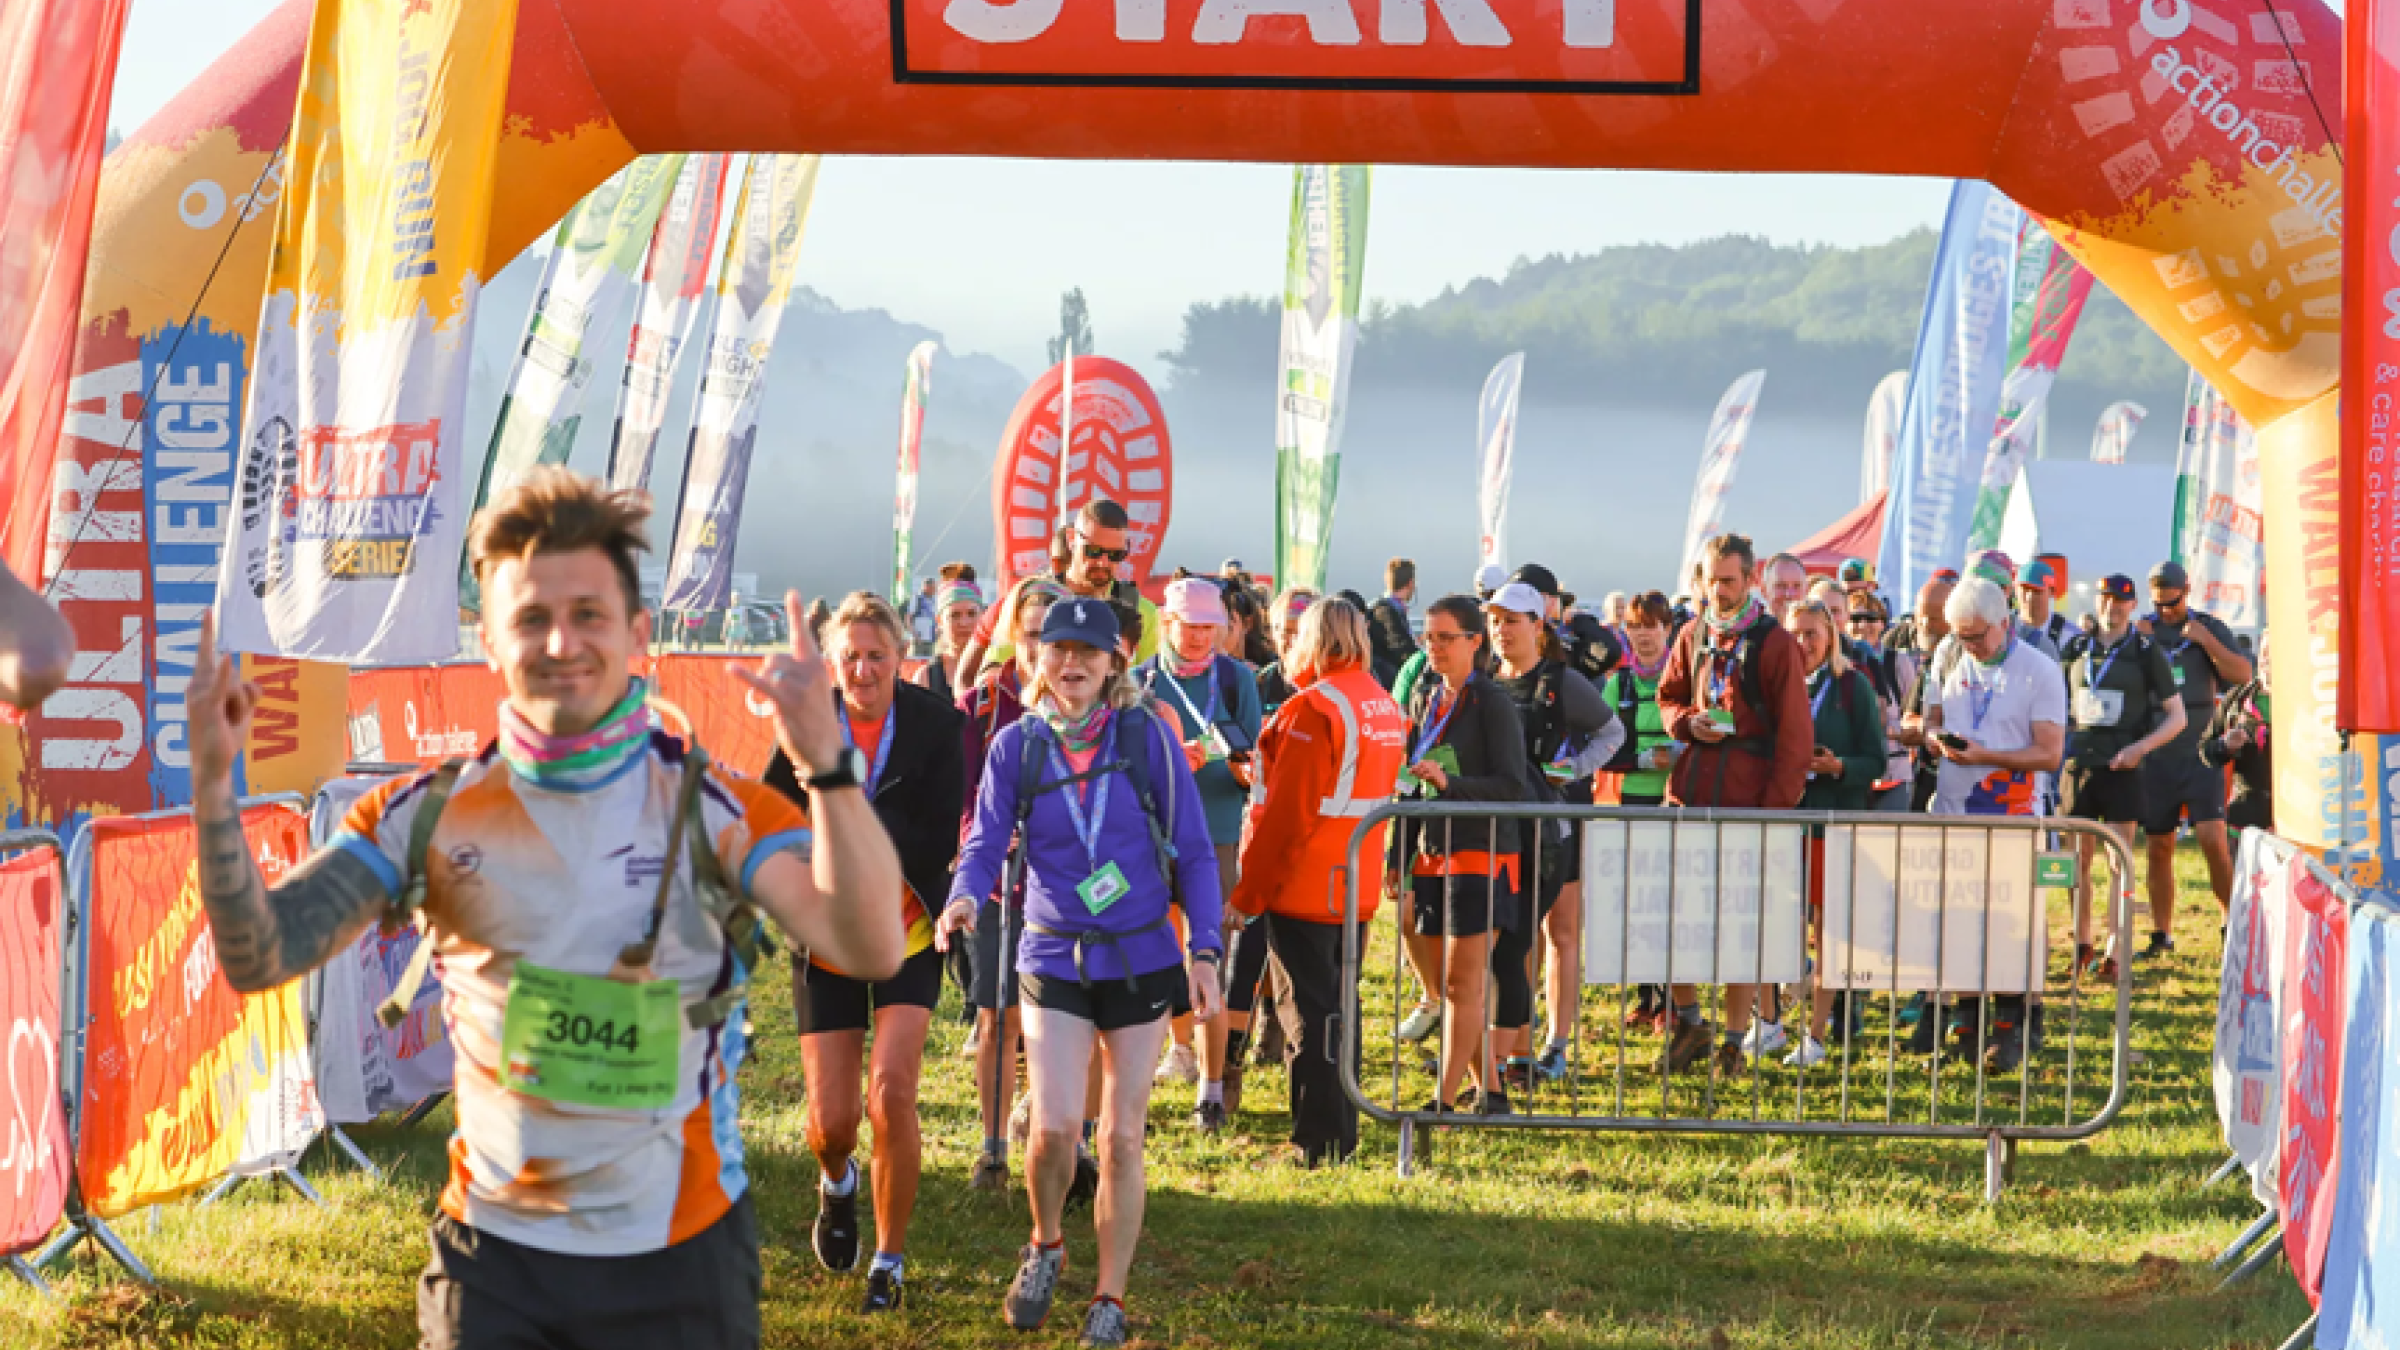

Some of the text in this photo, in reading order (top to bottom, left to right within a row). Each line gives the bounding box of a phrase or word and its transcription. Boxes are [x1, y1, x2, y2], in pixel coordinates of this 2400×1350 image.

[2367, 392, 2393, 465] care
[304, 437, 435, 497] ULTRA
[41, 360, 144, 771] ULTRA
[545, 1010, 640, 1055] 3044
